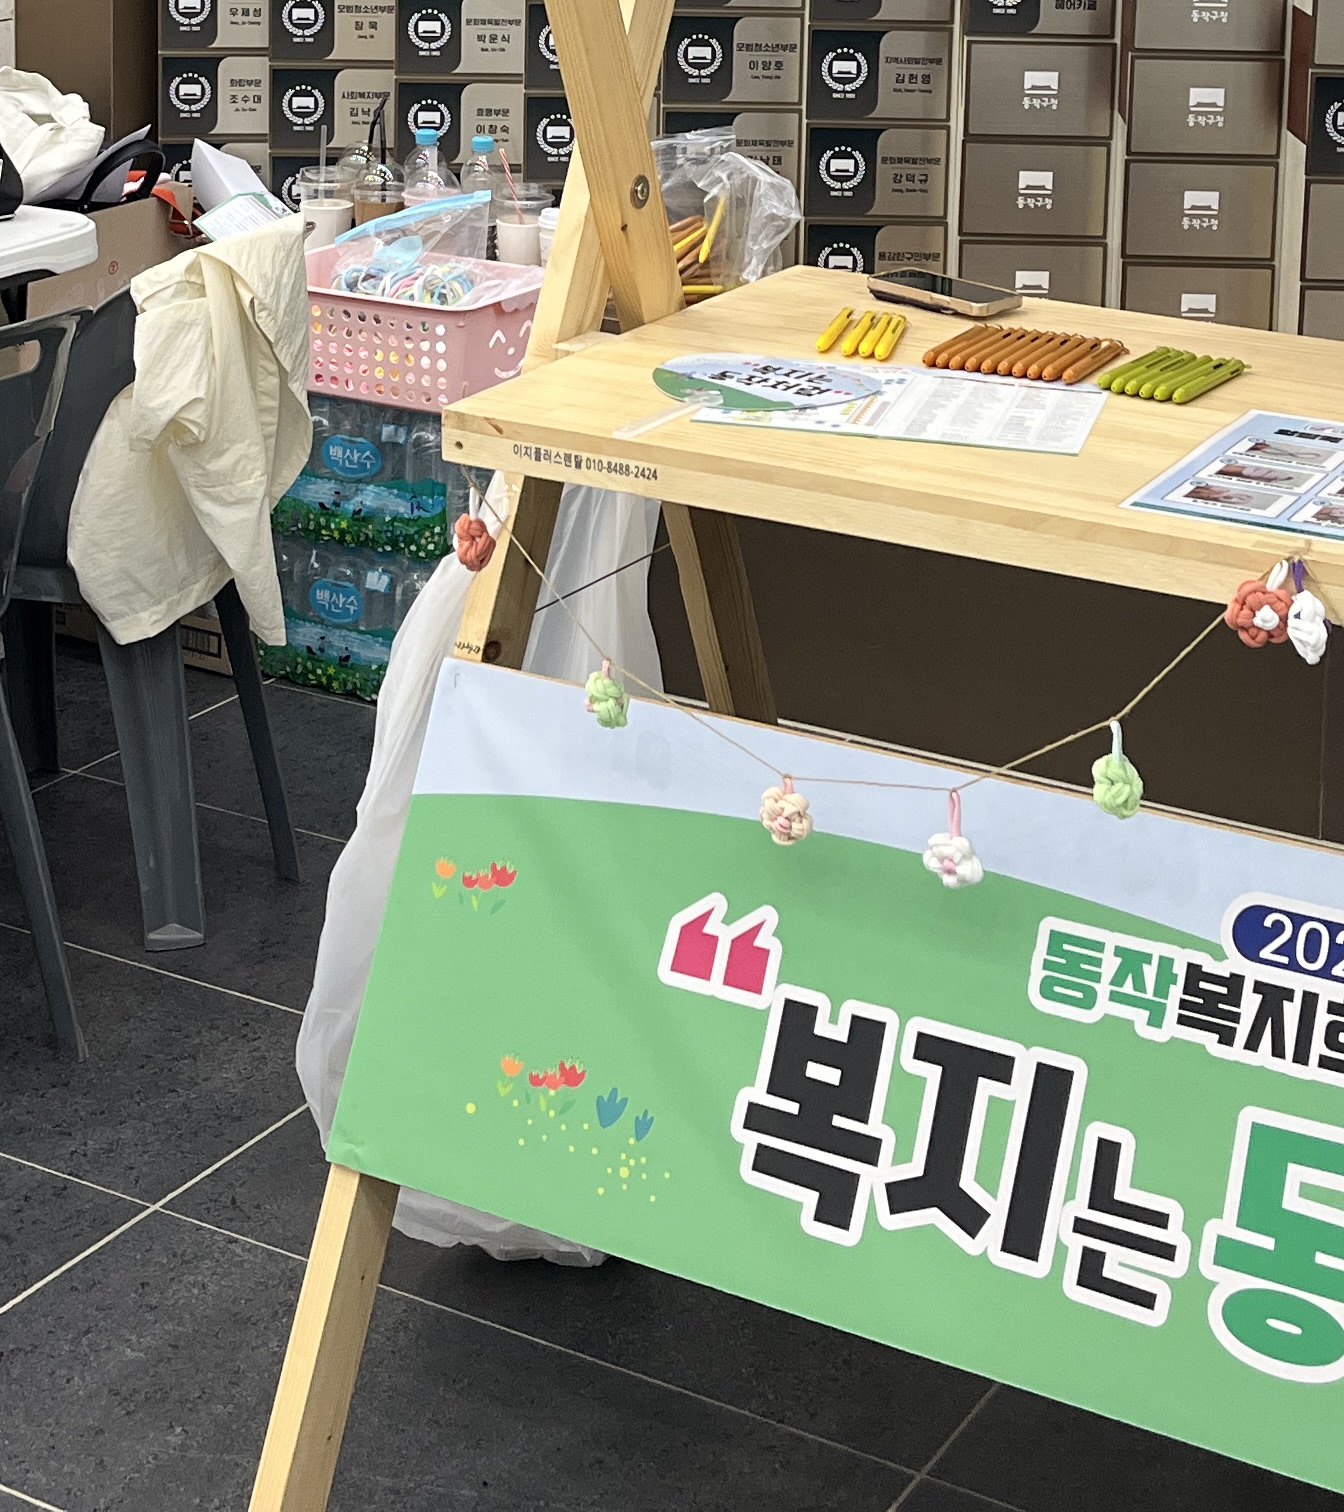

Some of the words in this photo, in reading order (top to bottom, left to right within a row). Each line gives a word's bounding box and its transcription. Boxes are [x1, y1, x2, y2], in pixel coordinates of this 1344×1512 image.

[1022, 94, 1058, 109] 동작구청
[1187, 111, 1224, 126] 동작구청
[329, 445, 377, 469] 백산수
[585, 457, 658, 481] 010-8488-2424
[316, 589, 358, 615] 백산수
